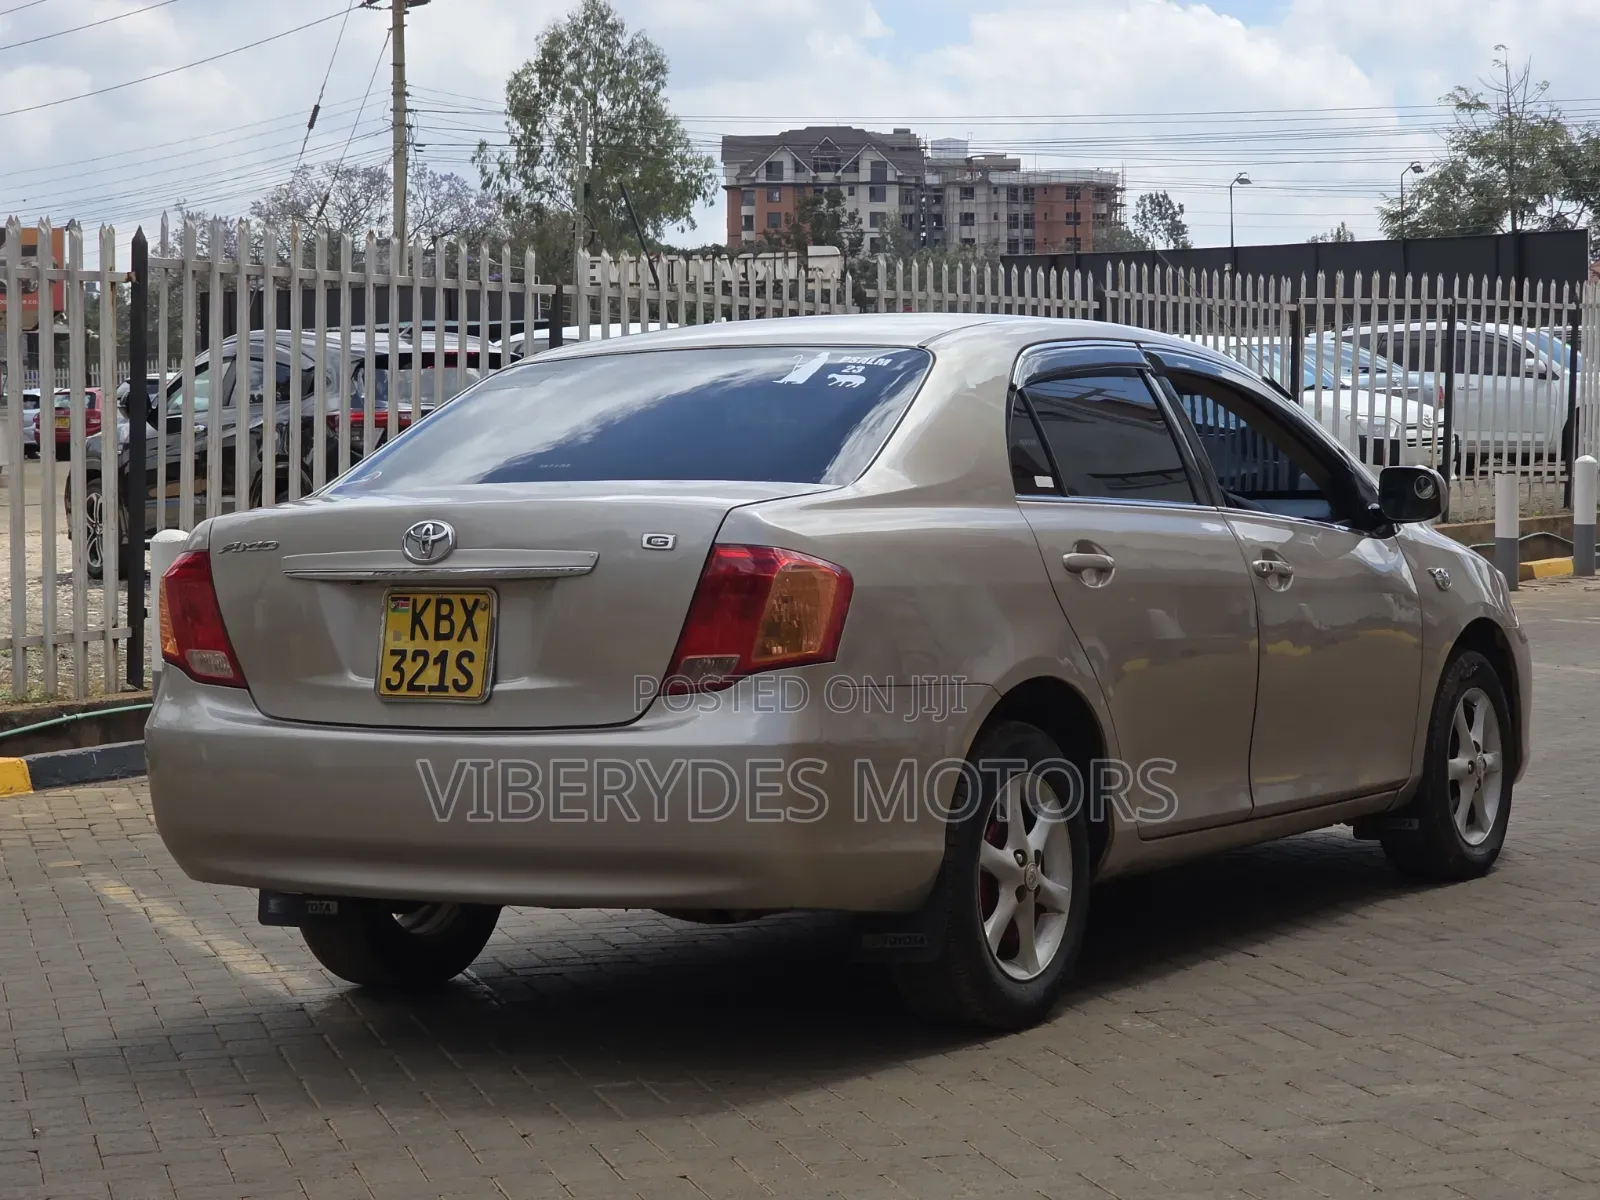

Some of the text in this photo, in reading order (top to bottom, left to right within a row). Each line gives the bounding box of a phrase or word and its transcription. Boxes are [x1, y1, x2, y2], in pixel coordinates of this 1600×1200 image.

[839, 356, 892, 366] PSALM
[841, 365, 865, 373] 23
[646, 536, 669, 547] G
[410, 598, 480, 642] KBX
[385, 649, 475, 693] 321S
